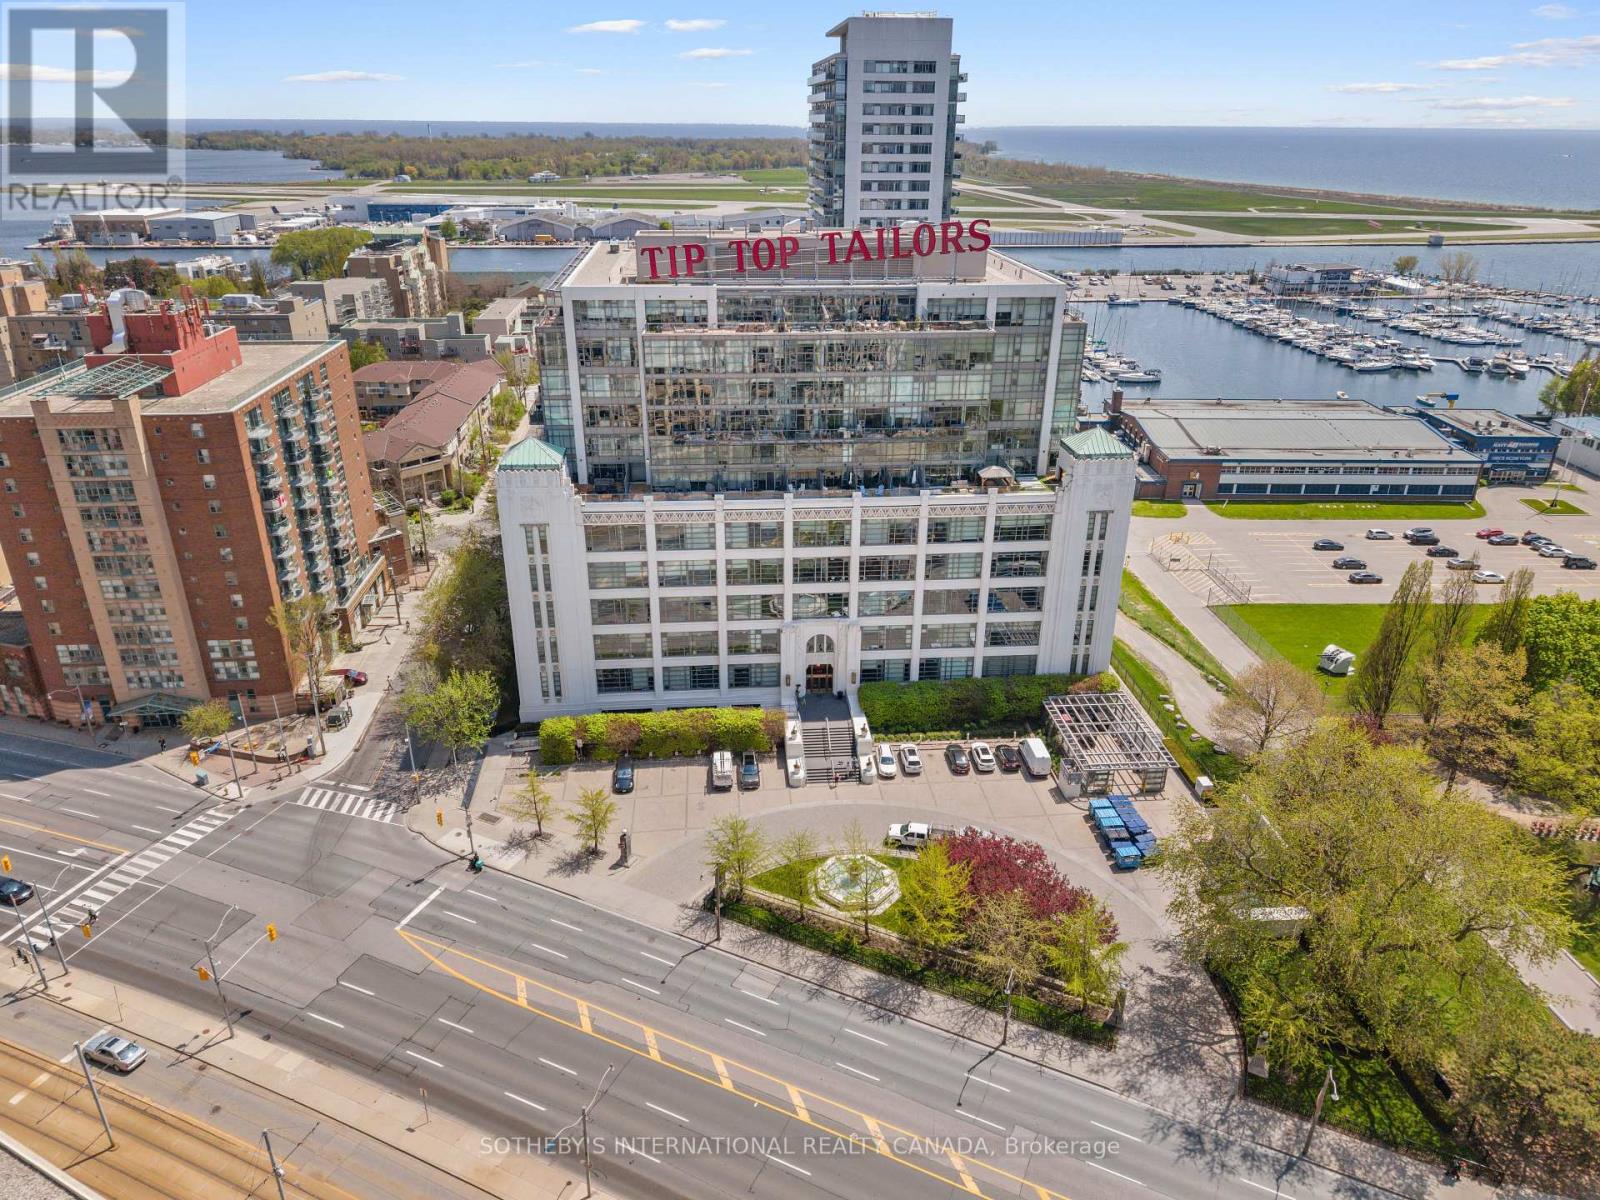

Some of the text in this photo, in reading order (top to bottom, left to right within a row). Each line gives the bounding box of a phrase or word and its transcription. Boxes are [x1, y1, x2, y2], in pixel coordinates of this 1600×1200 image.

[640, 219, 991, 279] TIP TOP TAILORS
